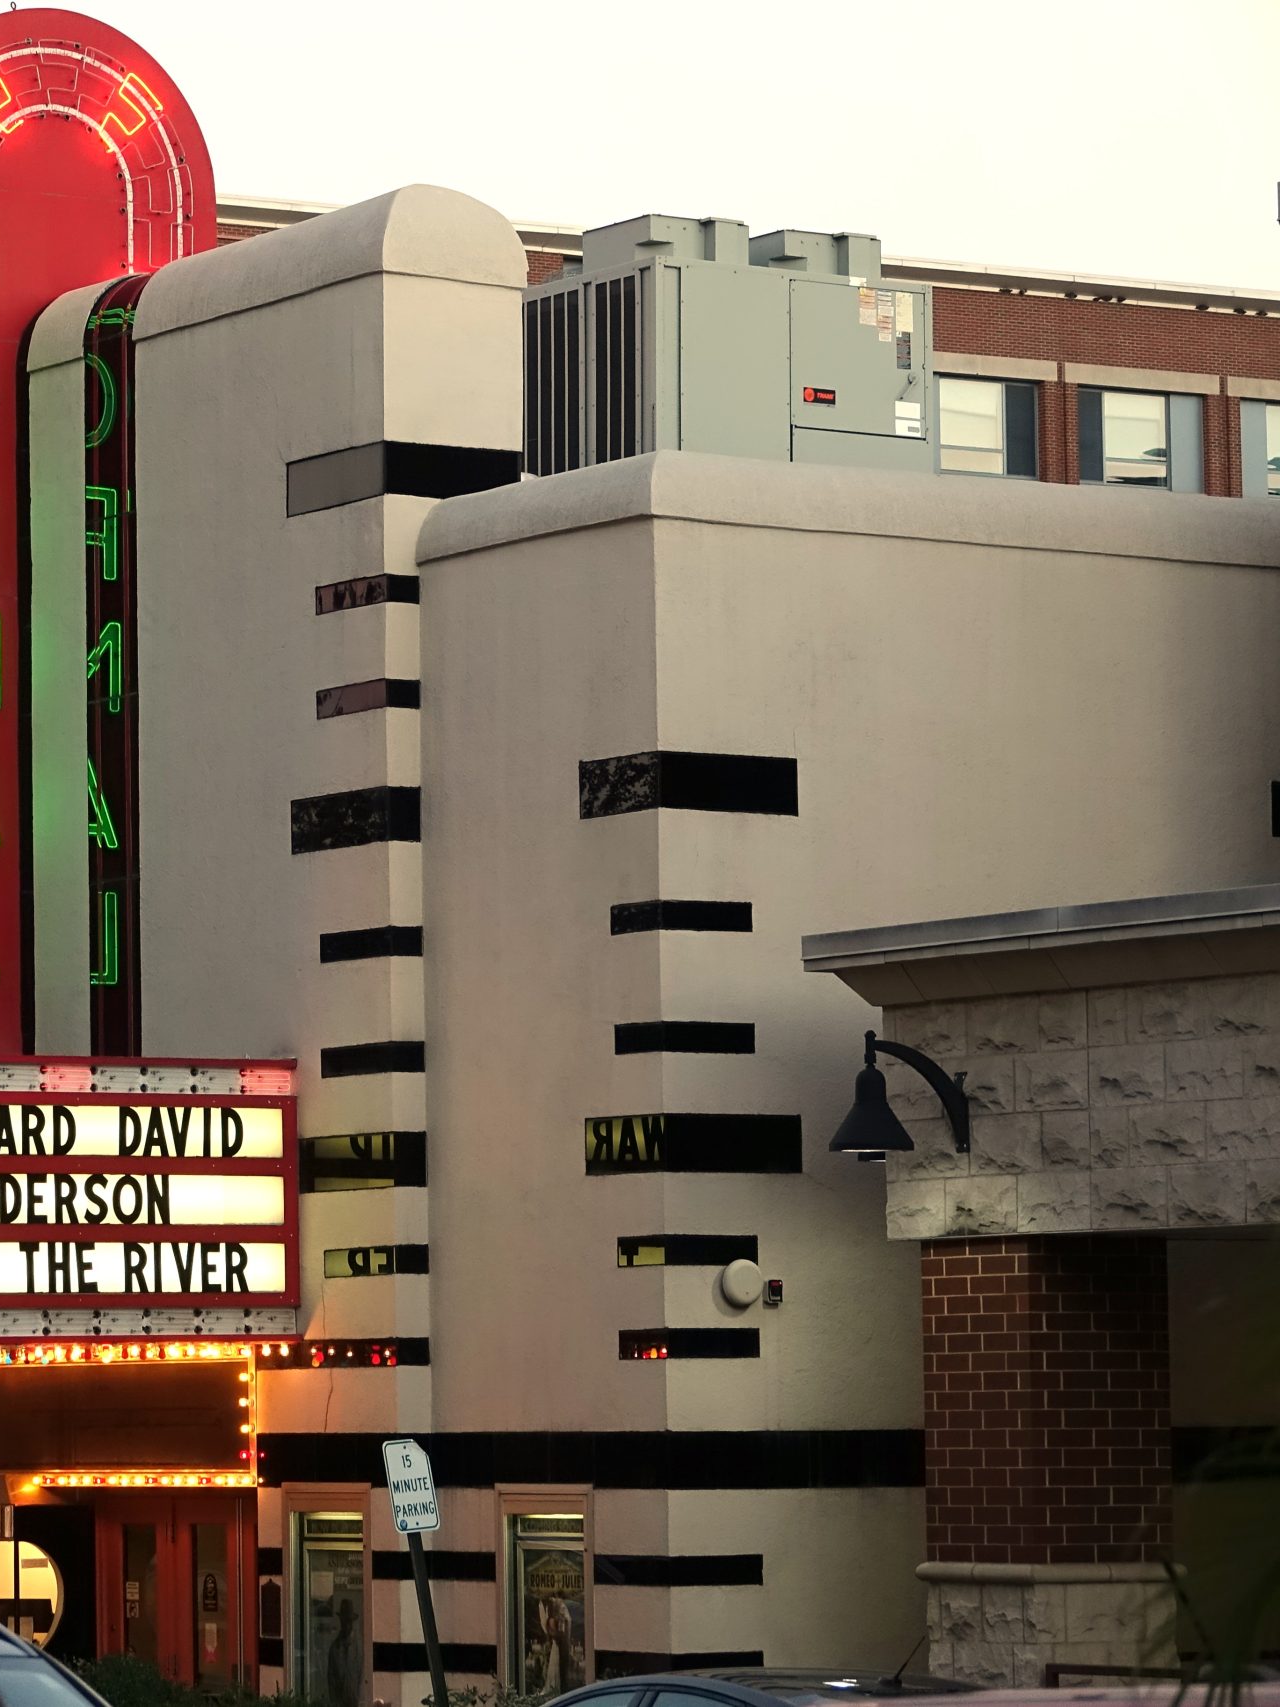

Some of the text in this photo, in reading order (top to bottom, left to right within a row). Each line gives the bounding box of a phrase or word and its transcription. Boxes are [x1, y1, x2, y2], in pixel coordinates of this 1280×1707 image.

[118, 1106, 244, 1158] DAVID
[20, 1242, 100, 1294] THE
[124, 1243, 250, 1294] RIVER
[401, 1454, 412, 1469] 15
[392, 1477, 430, 1494] MINUTE
[395, 1501, 435, 1518] PARKING
[530, 1574, 555, 1588] ROMEO
